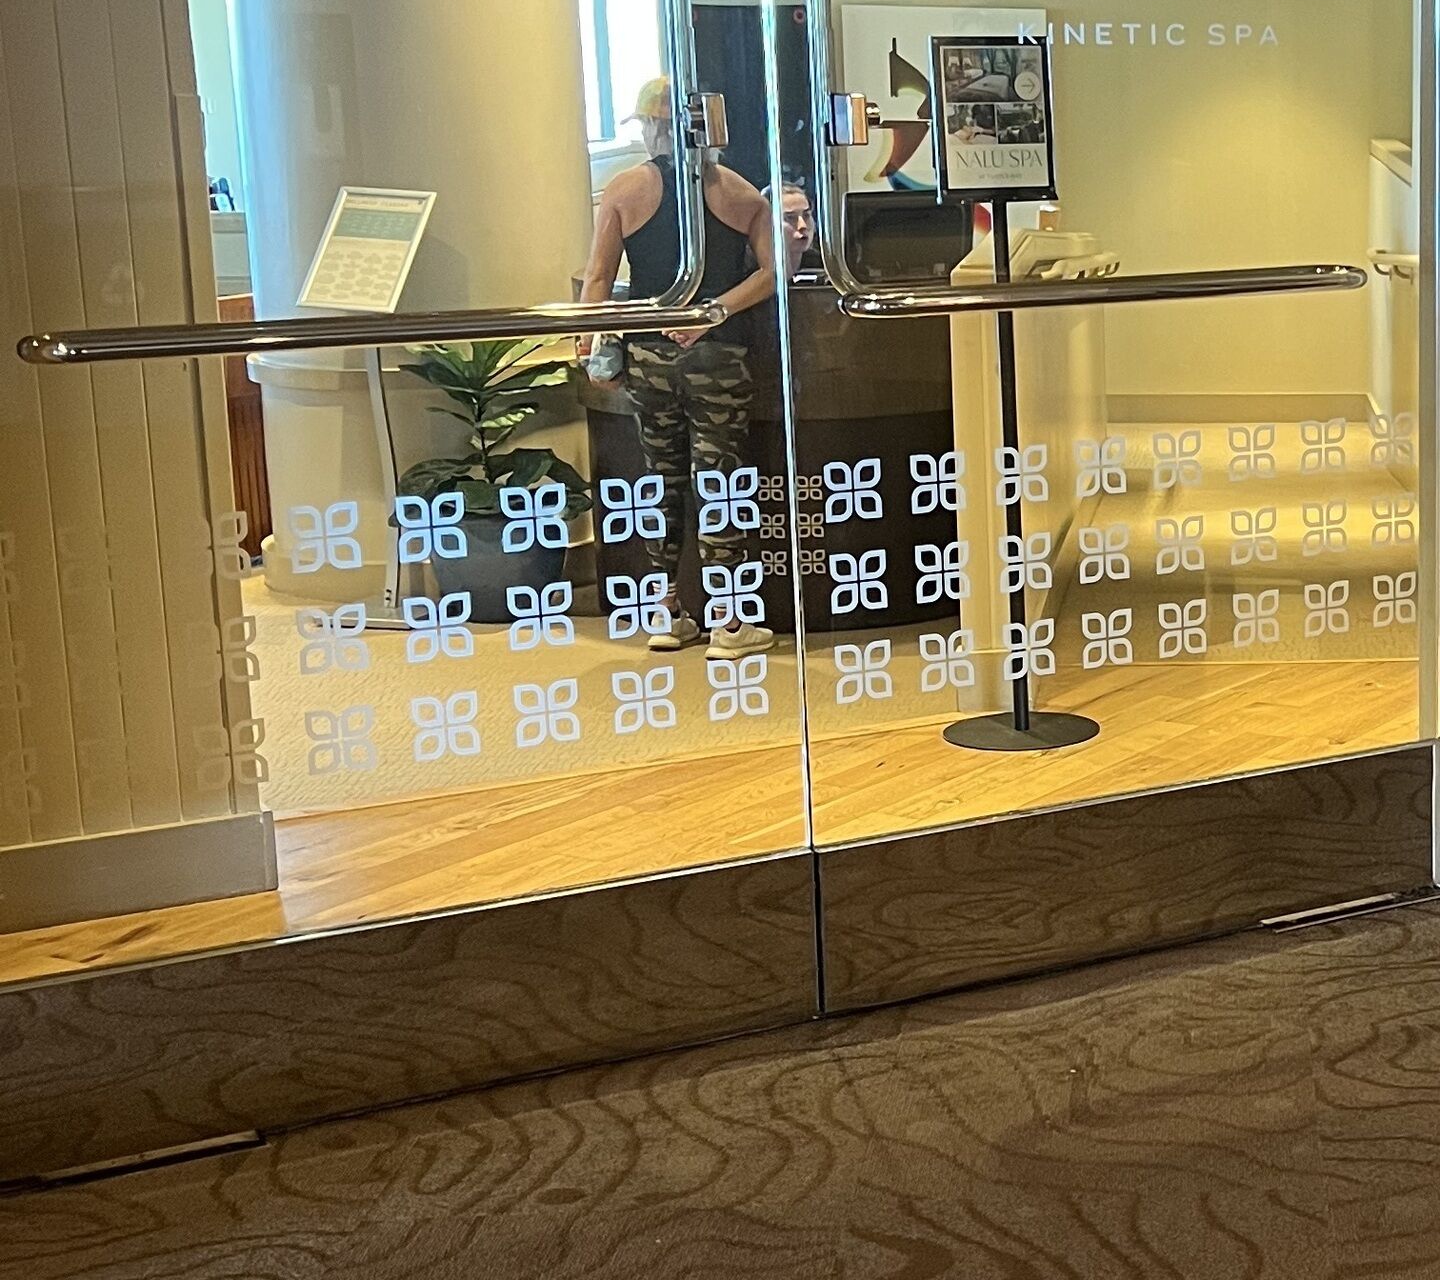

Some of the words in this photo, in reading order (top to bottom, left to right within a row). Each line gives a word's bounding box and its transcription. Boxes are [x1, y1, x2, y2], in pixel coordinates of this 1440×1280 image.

[1017, 21, 1186, 46] KINETIC
[1208, 23, 1280, 46] SPA
[955, 150, 1003, 169] NALU
[1008, 148, 1043, 168] SPA
